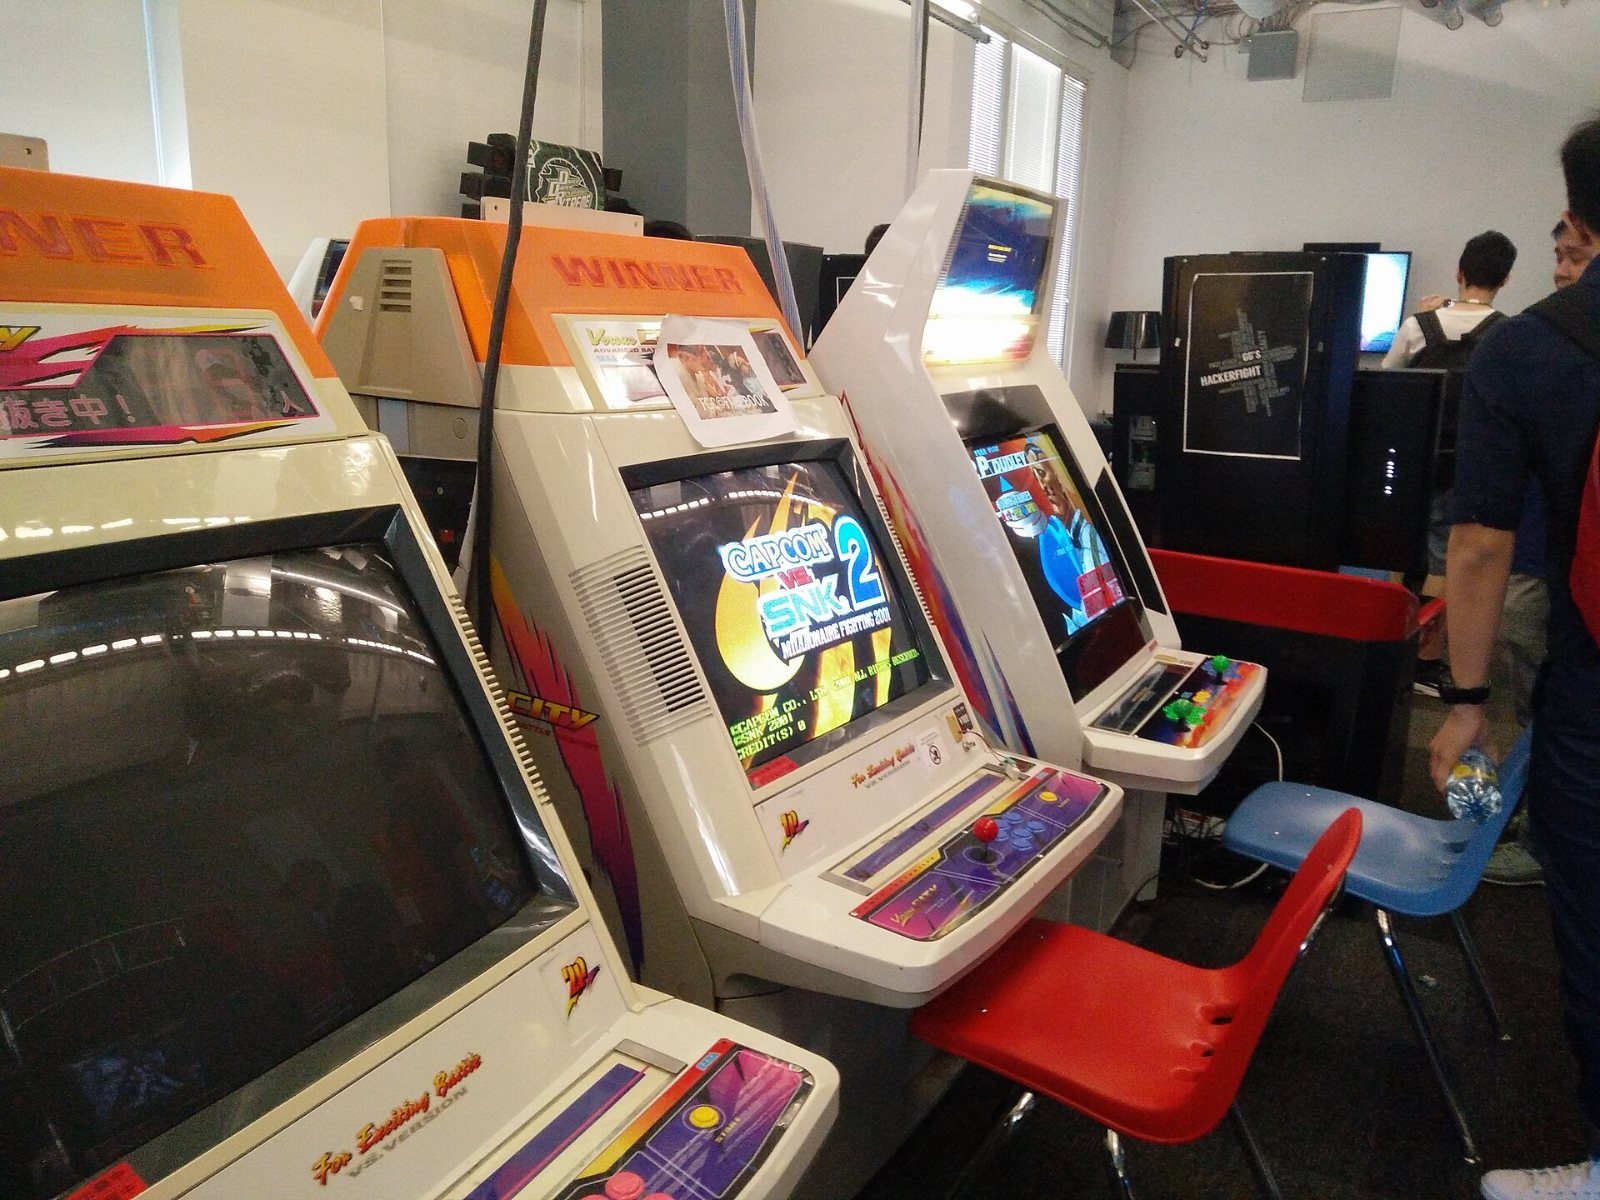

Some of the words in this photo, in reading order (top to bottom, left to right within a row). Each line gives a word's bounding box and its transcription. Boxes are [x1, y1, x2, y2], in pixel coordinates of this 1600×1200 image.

[551, 254, 744, 293] WINNER
[1200, 365, 1261, 387] HACKERFIGHT
[991, 452, 1027, 473] DUDLEY
[720, 523, 834, 581] CAPCOM
[833, 515, 886, 610] 2
[759, 577, 848, 637] SNK
[839, 609, 876, 637] FIGHTING
[506, 690, 600, 731] CITY
[737, 726, 793, 760] CREDIT(S)
[382, 1086, 468, 1151] VERSION
[312, 1152, 352, 1185] For
